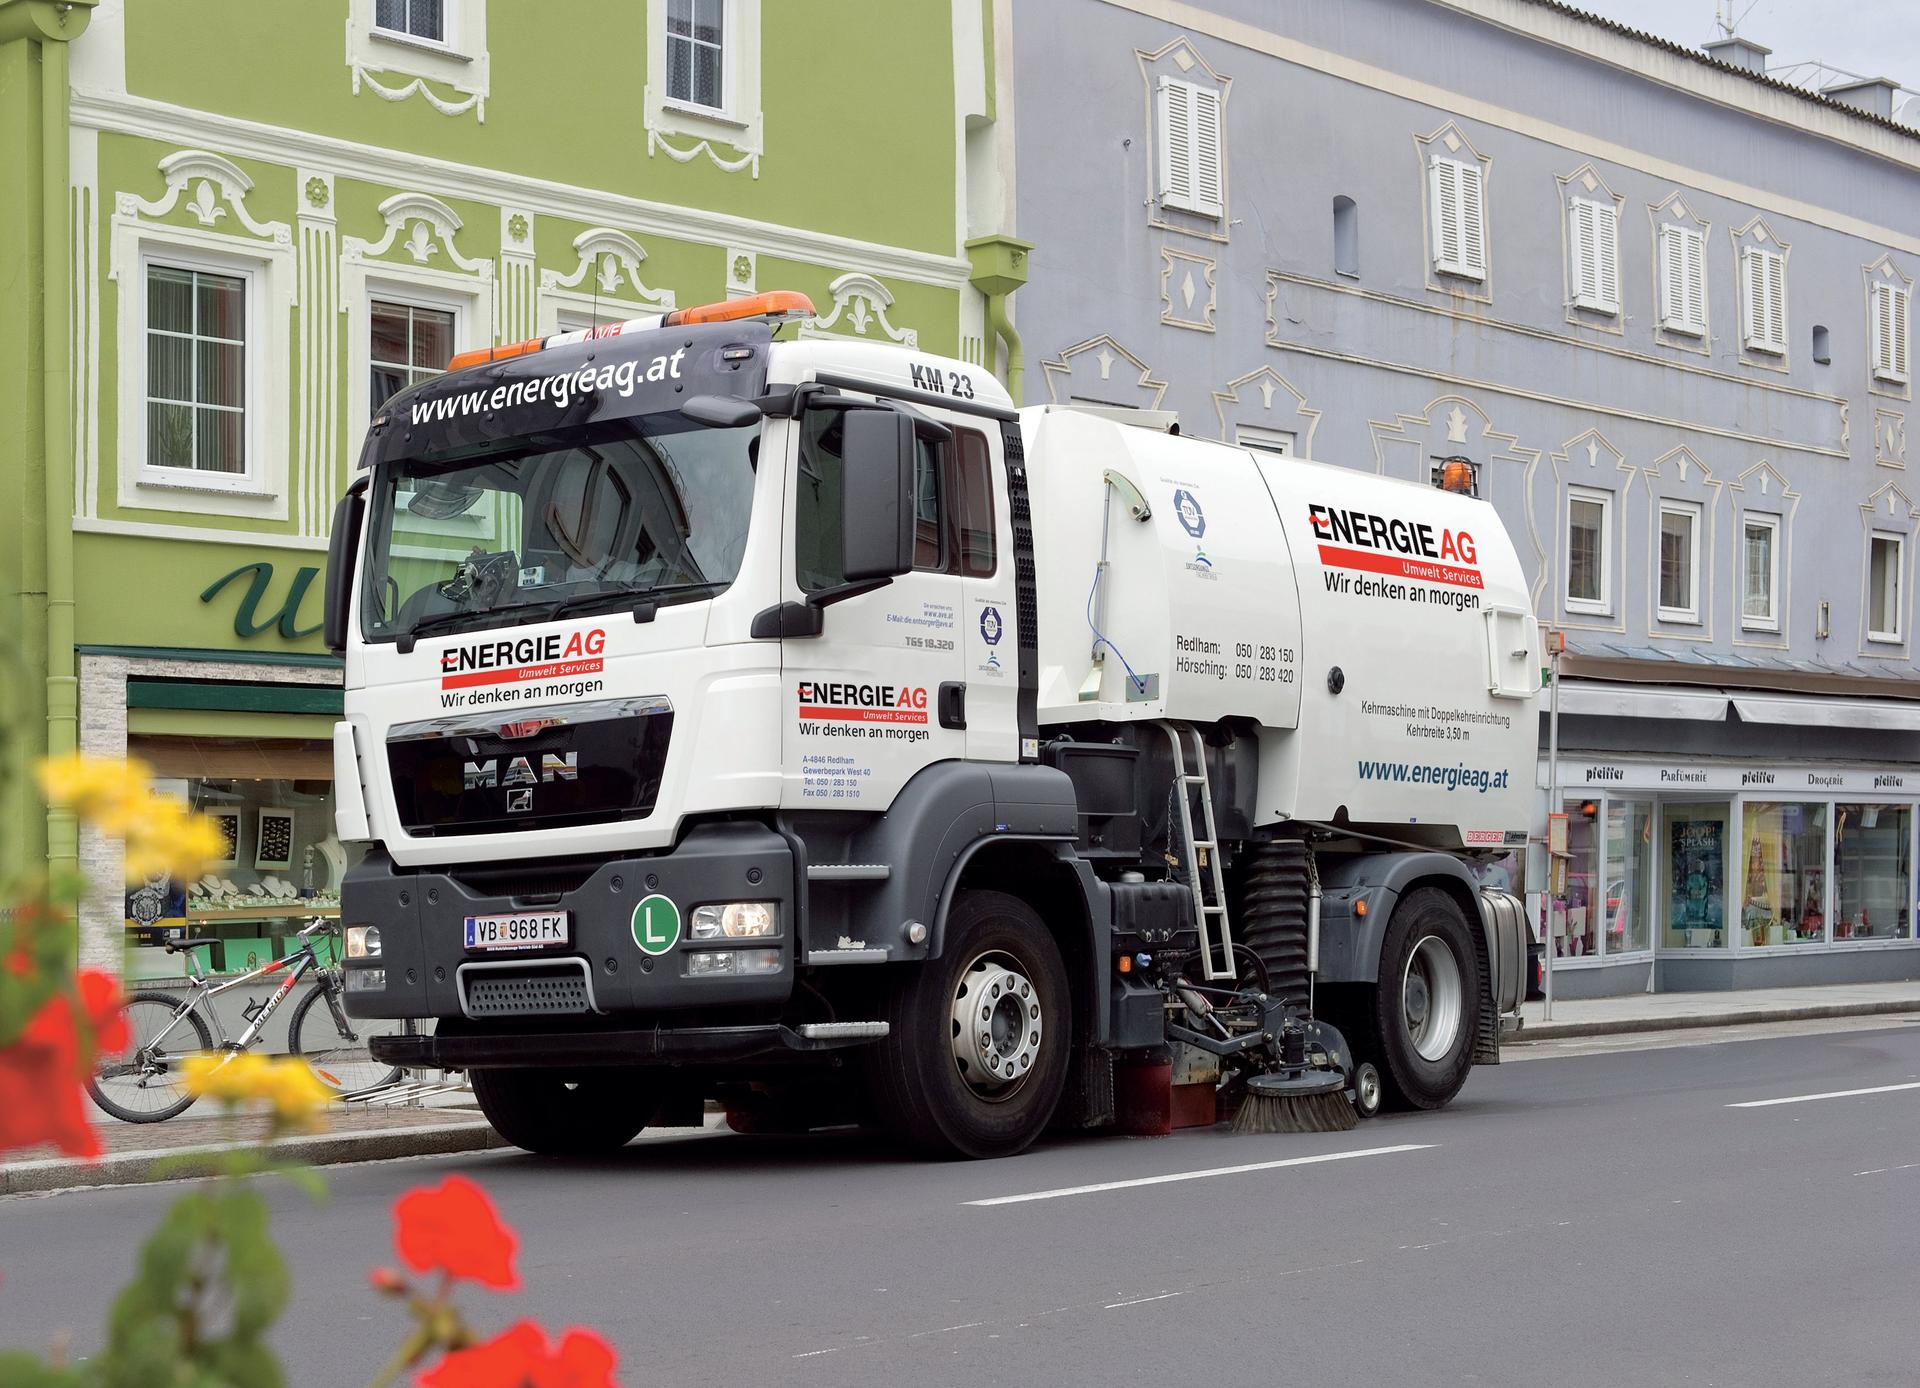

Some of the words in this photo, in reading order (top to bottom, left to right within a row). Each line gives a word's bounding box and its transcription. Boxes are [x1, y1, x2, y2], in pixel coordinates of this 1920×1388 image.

[411, 348, 685, 425] www.energieag.at
[910, 362, 945, 393] KM
[949, 372, 974, 400] 23
[1309, 503, 1439, 559] ENERGIE
[1440, 528, 1478, 565] AG
[1402, 561, 1440, 579] Umwelt
[1442, 568, 1481, 585] Services
[1324, 571, 1350, 593] Wir
[1354, 575, 1406, 600] denken
[1409, 586, 1426, 602] an
[1429, 588, 1480, 612] morgen
[440, 634, 561, 673] ENERGIE
[562, 628, 606, 658] AG
[905, 636, 923, 648] TGS
[924, 638, 955, 651] 18.320
[1176, 634, 1221, 655] Redlham:
[1235, 643, 1252, 658] 050
[1260, 646, 1276, 661] 283
[1278, 648, 1294, 663] 150
[518, 666, 557, 679] Umwelt
[560, 662, 601, 674] Services
[1176, 656, 1228, 680] Hörsching:
[1235, 664, 1252, 679] 050
[1259, 666, 1276, 682] 283
[1278, 668, 1294, 683] 420
[441, 692, 465, 708] Wir
[468, 688, 520, 704] denken
[525, 687, 542, 699] an
[546, 679, 603, 697] morgen
[797, 682, 895, 707] ENERGIE
[895, 687, 928, 709] AG
[863, 711, 893, 720] Umwelt
[895, 712, 926, 722] Services
[1361, 700, 1416, 719] Kehrmaschine
[1417, 706, 1430, 719] mit
[1431, 706, 1510, 729] Doppelkehreinrichtung
[799, 722, 820, 736] Wir
[822, 723, 866, 737] denken
[868, 728, 883, 738] an
[886, 728, 929, 743] morgen
[1406, 723, 1445, 739] Kehrbreite
[1446, 727, 1461, 742] 3,50
[1462, 731, 1470, 741] m
[463, 751, 578, 791] MAN
[802, 755, 826, 764] A-4846
[827, 755, 855, 765] Redlham
[802, 766, 846, 776] Gewerbepark
[846, 767, 862, 776] West
[863, 768, 871, 776] 40
[804, 777, 815, 785] Tel.
[816, 778, 829, 786] 050
[833, 778, 845, 787] 283
[846, 779, 857, 787] 150
[1358, 760, 1509, 793] www.energieag.at
[802, 788, 815, 797] Fax
[815, 788, 828, 797] 050
[832, 789, 845, 798] 283
[846, 790, 861, 798] 1510
[1467, 832, 1504, 842] BERGER
[1680, 837, 1715, 847] SPLASH
[479, 921, 497, 942] VB
[509, 918, 538, 940] 968
[542, 917, 561, 938] FK
[645, 906, 666, 943] L
[253, 985, 289, 1030] MERIDA
